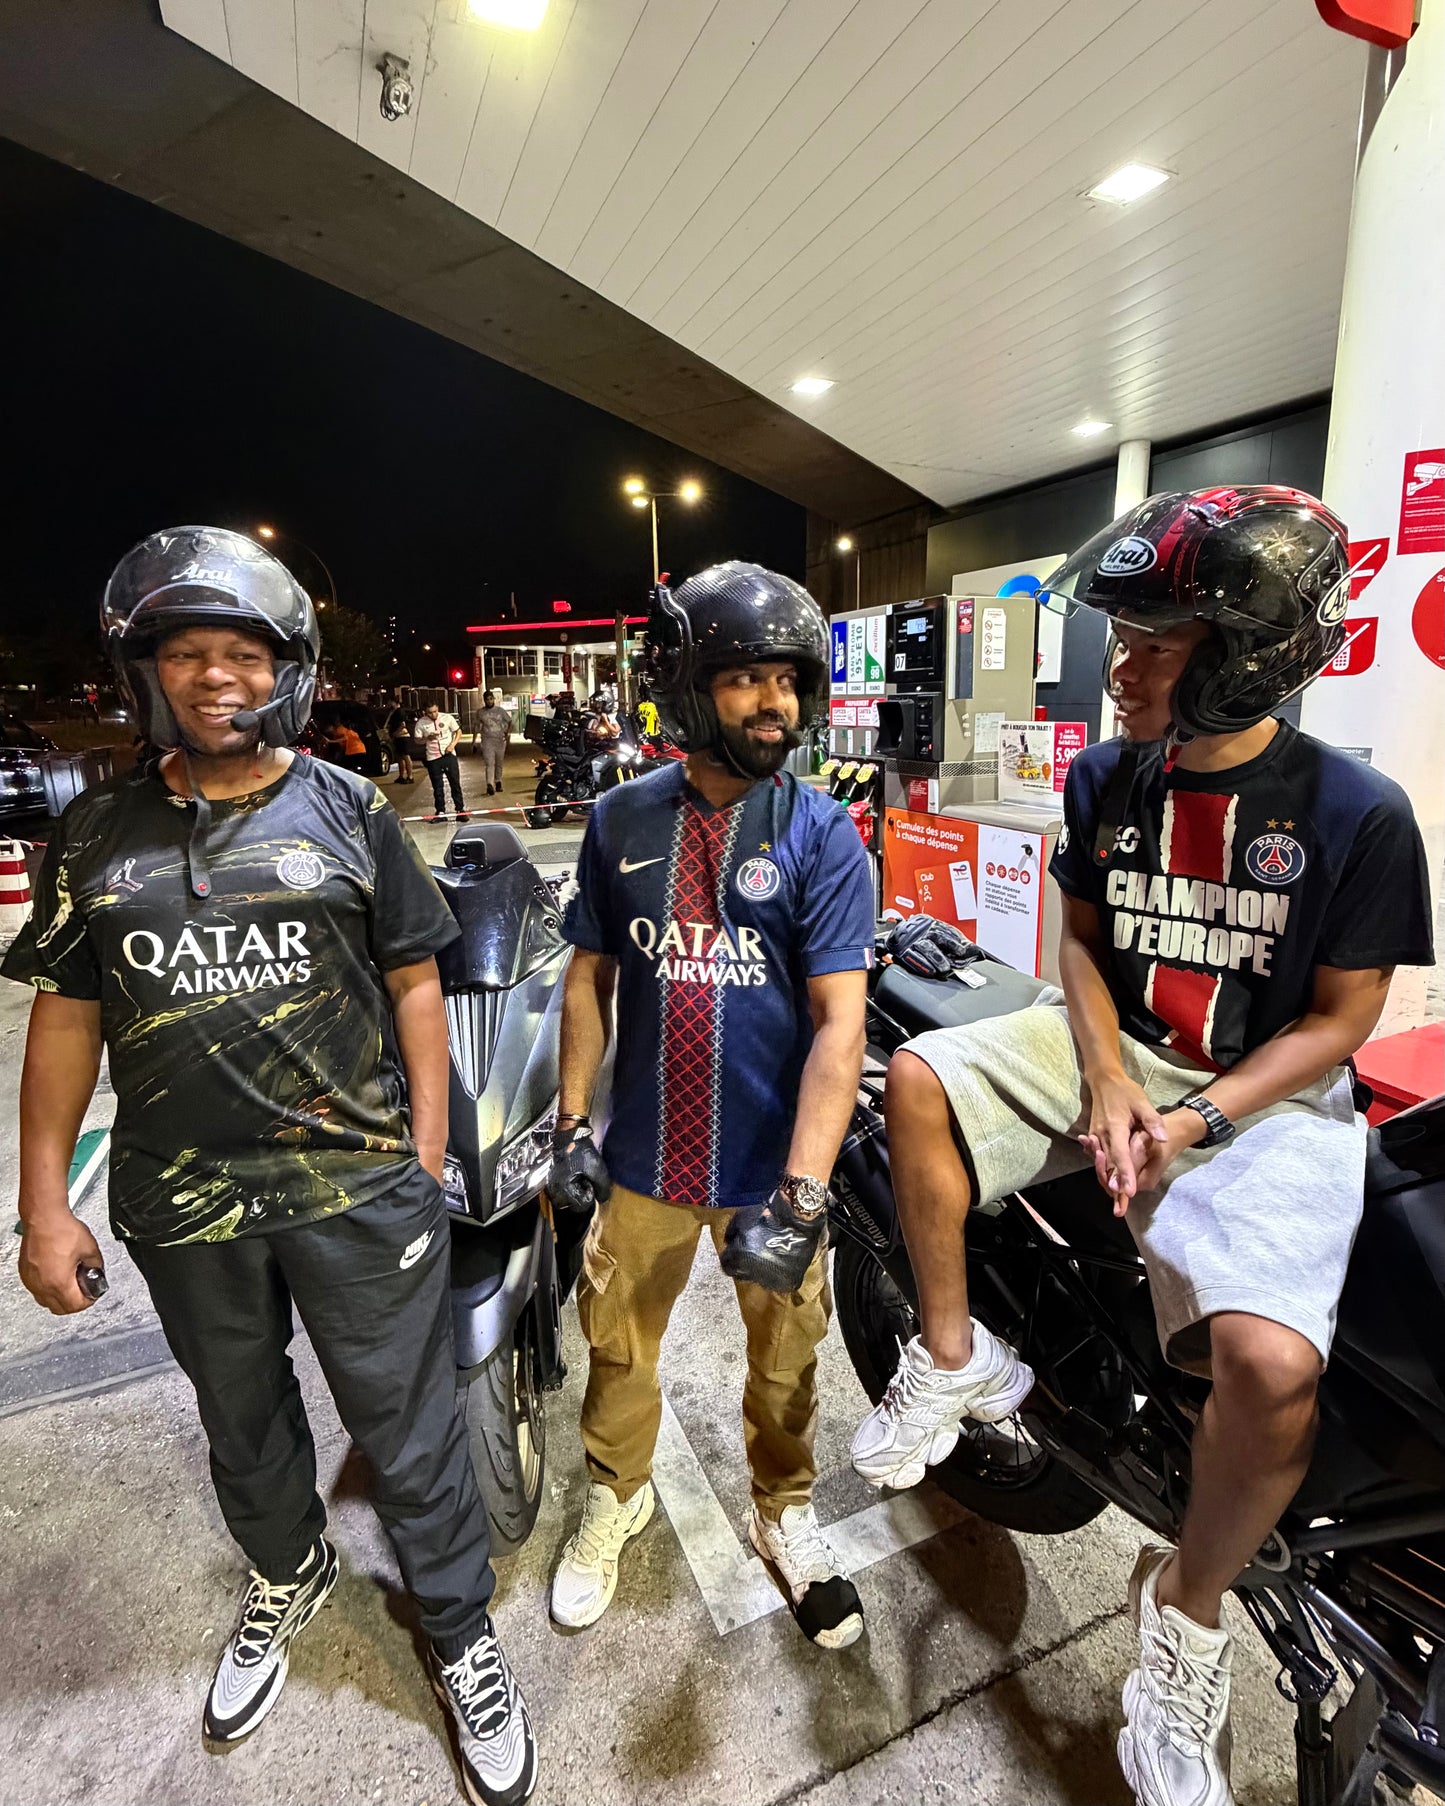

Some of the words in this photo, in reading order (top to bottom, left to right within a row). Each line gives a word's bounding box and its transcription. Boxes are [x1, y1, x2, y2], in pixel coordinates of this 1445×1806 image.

[1106, 541, 1149, 566] Arai
[171, 561, 233, 581] Arai
[855, 626, 863, 674] 95-E10
[895, 655, 905, 669] 07
[870, 668, 880, 680] 98
[1055, 747, 1084, 764] 5,99
[896, 819, 925, 834] Cumulez
[925, 826, 939, 837] des
[940, 830, 965, 842] points
[896, 829, 901, 839] à
[901, 831, 926, 844] chaque
[926, 837, 959, 852] dépense
[1256, 836, 1296, 850] PARIS
[287, 853, 317, 864] PARIS
[746, 860, 775, 872] PARIS
[920, 872, 935, 882] Club
[1106, 869, 1290, 936] CHAMPION
[122, 921, 311, 978] QATAR
[629, 917, 766, 960] QATAR
[1113, 911, 1275, 977] D'EUROPE
[170, 960, 312, 995] AIRWAYS
[654, 960, 767, 986] AIRWAYS
[405, 1230, 429, 1259] NIKE
